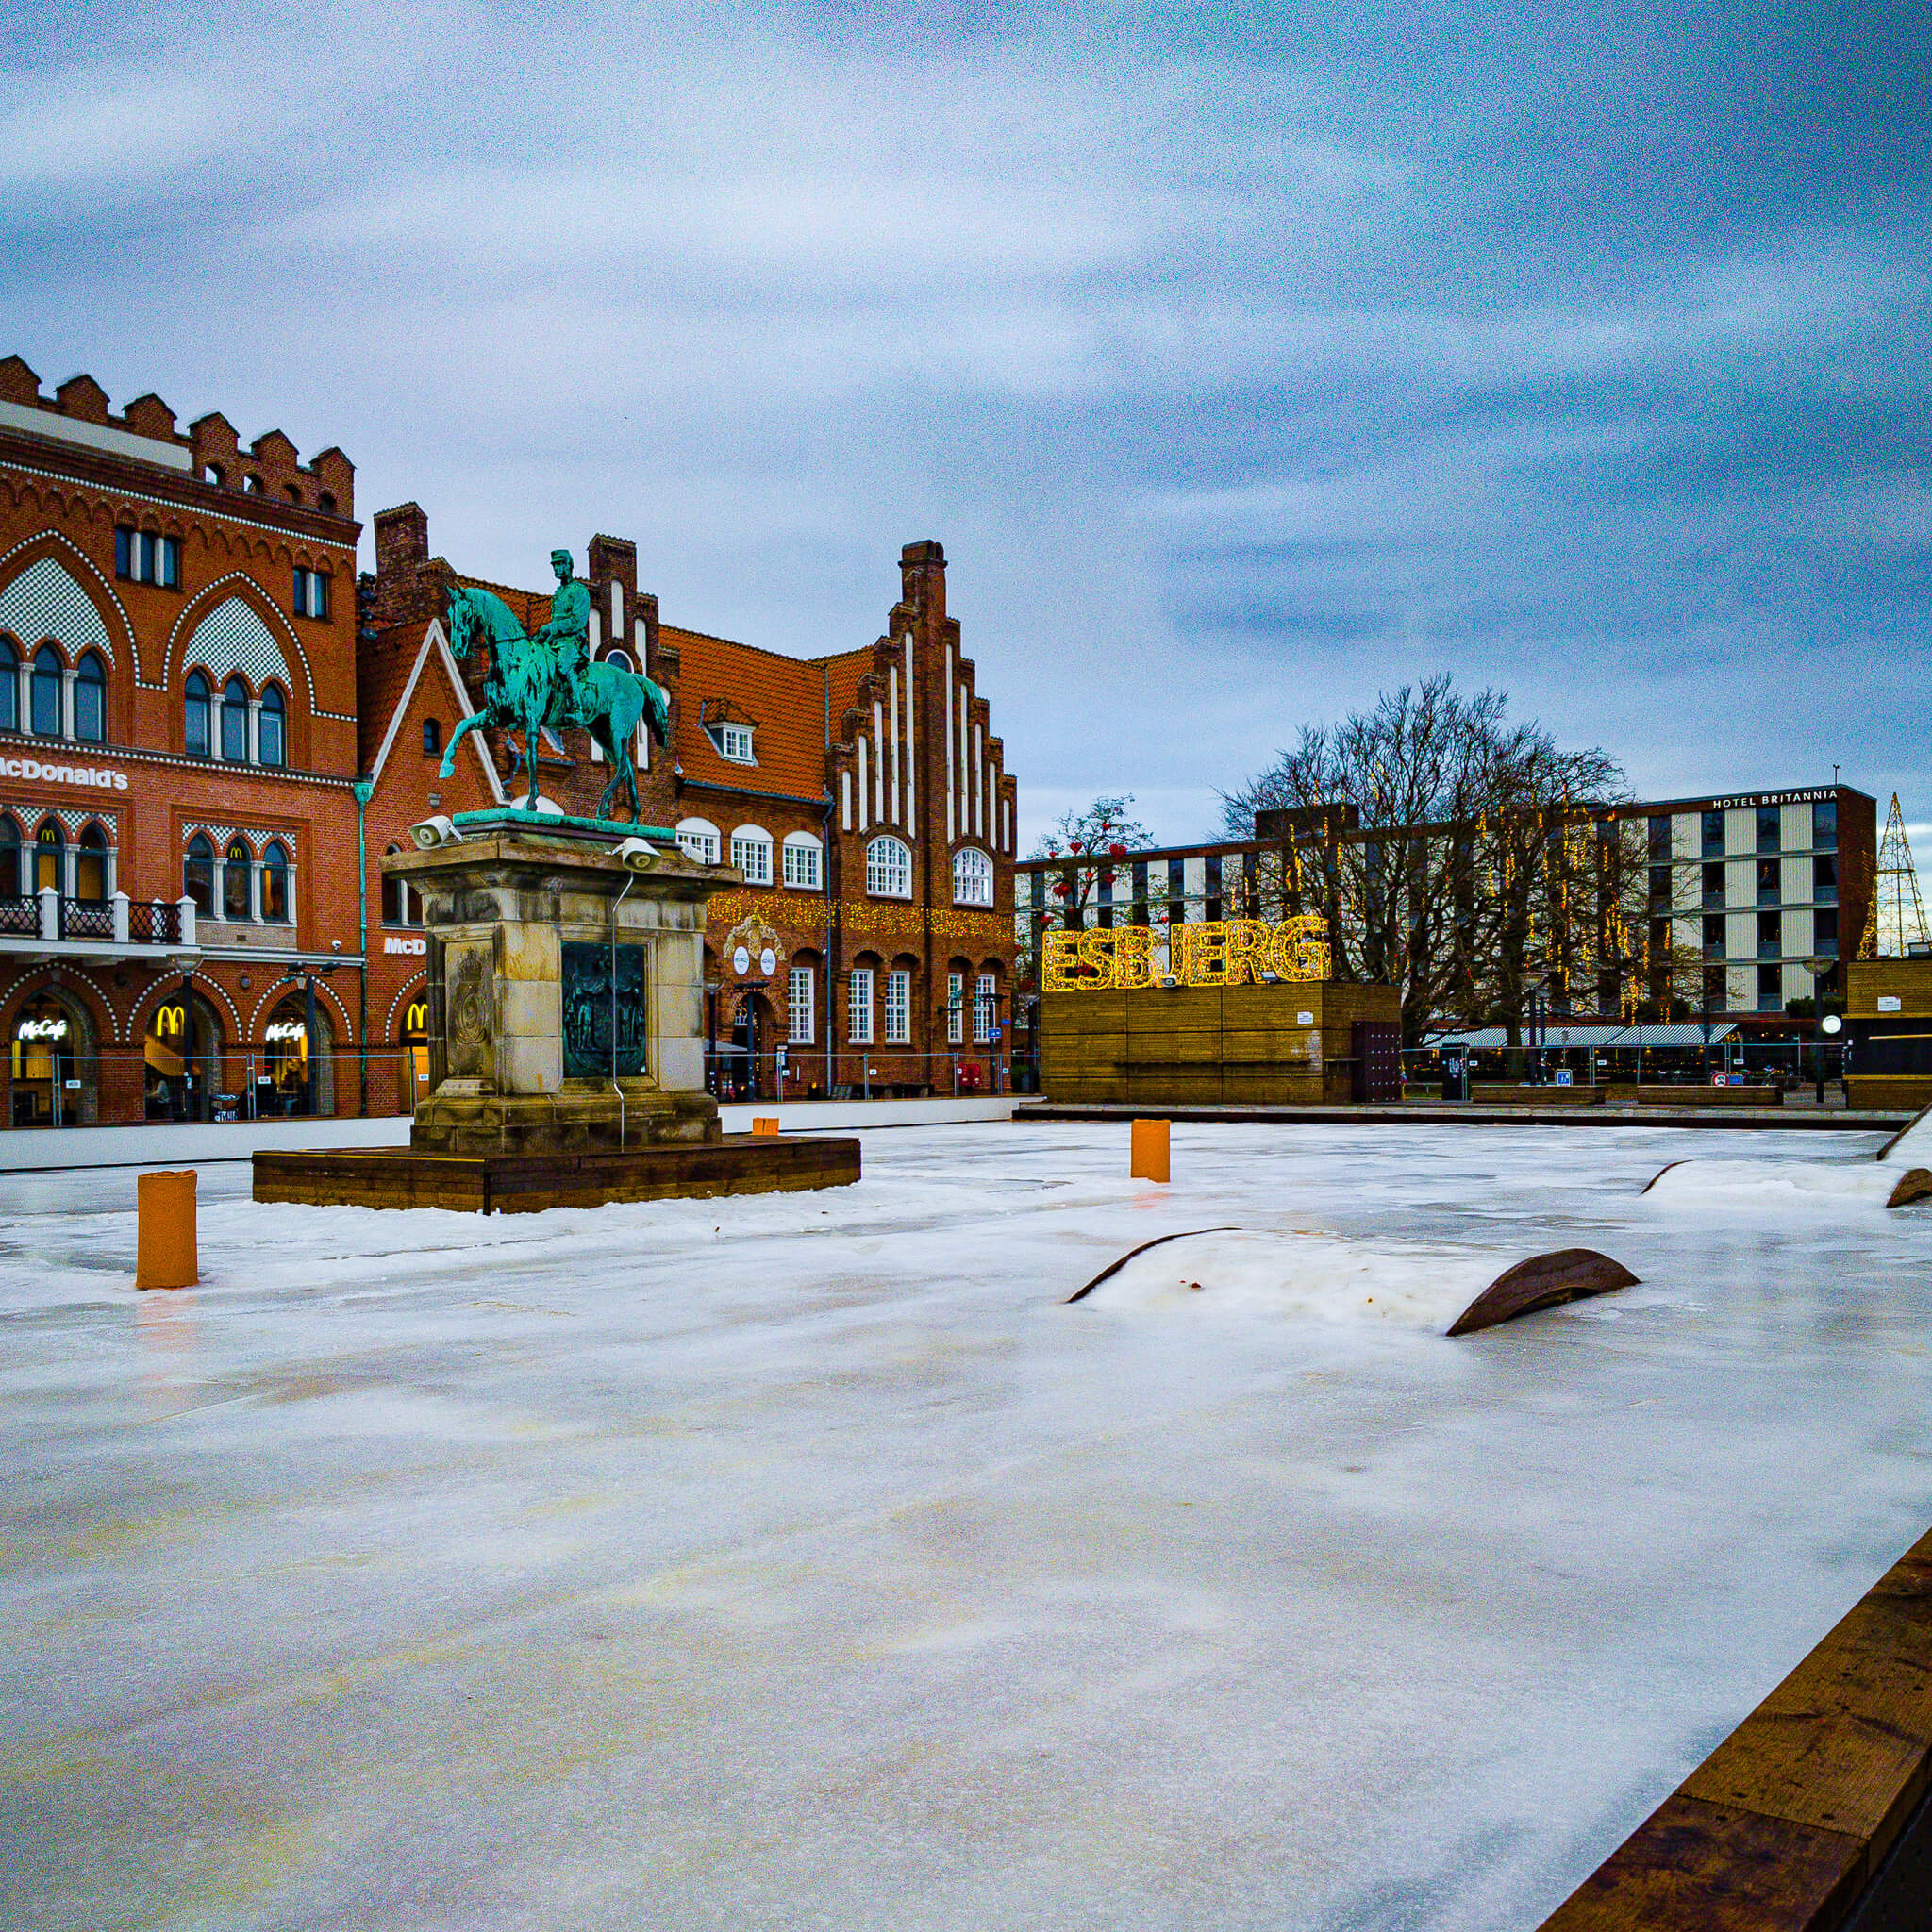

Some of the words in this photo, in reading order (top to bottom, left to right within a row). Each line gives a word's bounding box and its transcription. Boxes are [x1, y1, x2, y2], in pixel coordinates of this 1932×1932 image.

[1712, 797, 1756, 808] HOTEL
[1761, 790, 1838, 805] BRITANNIA
[1042, 915, 1332, 991] ESBJERG
